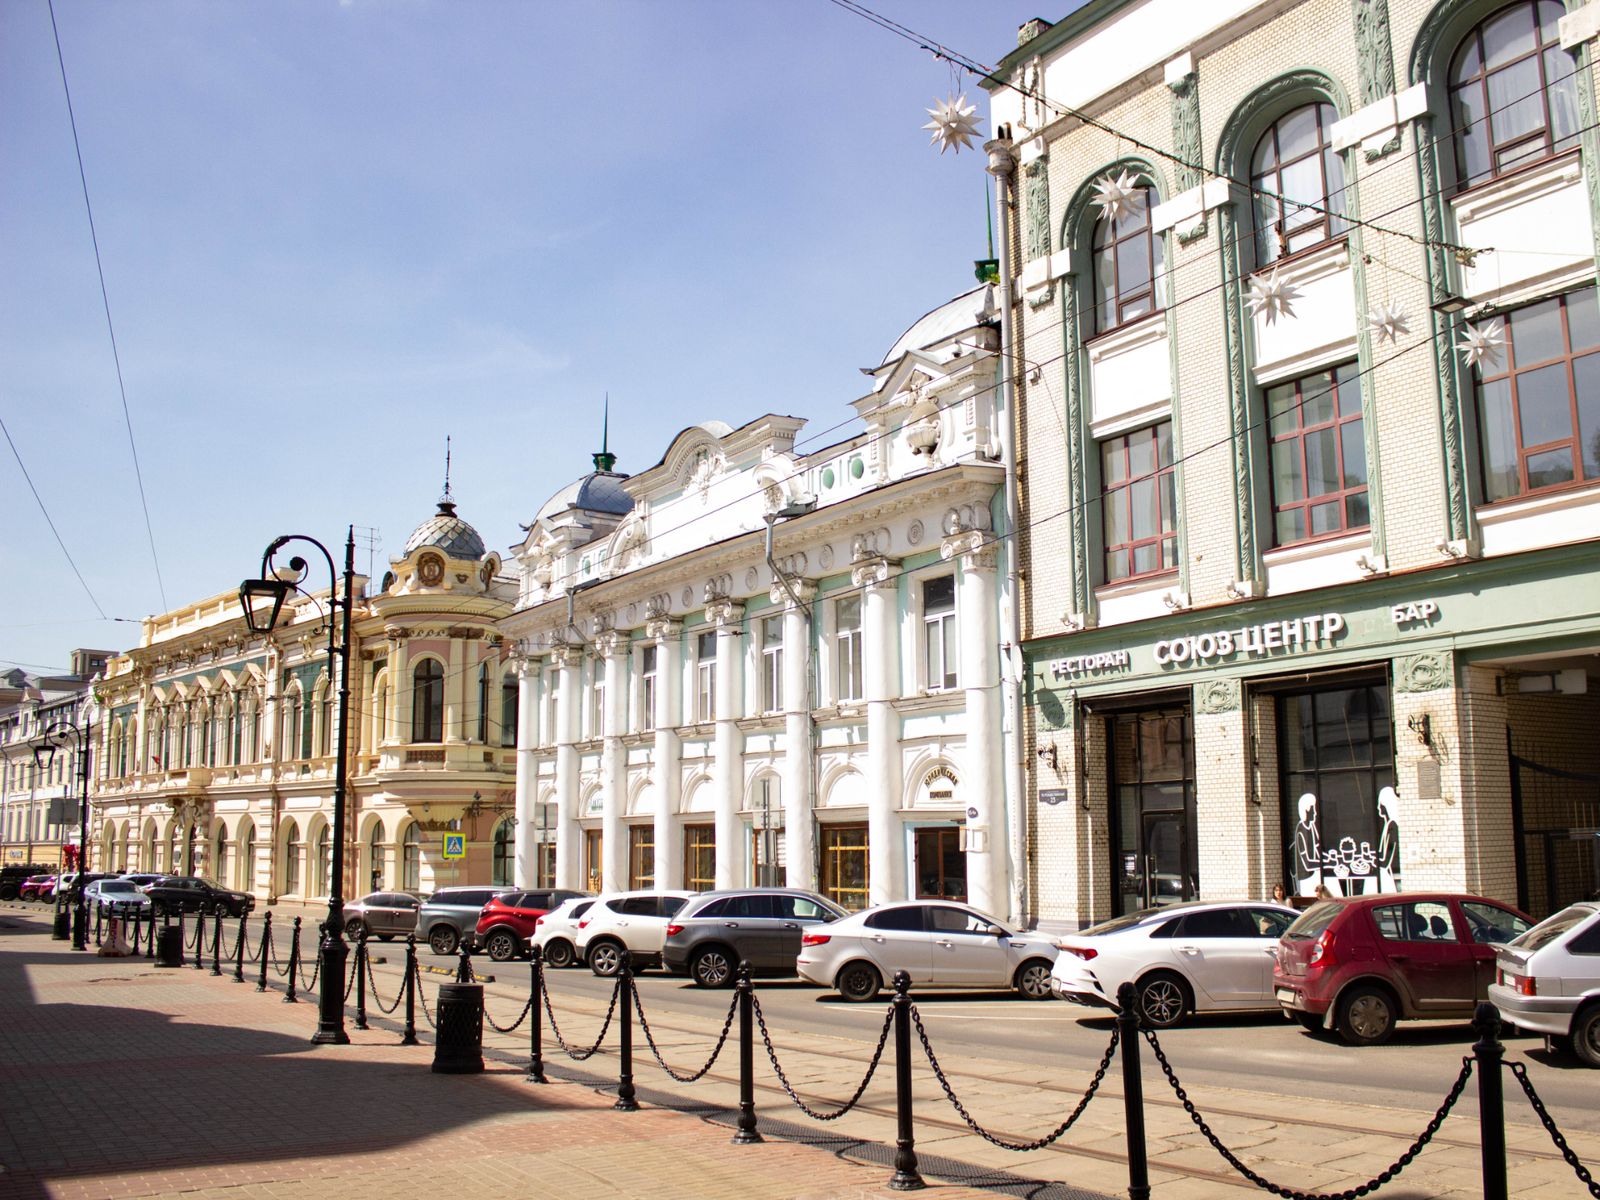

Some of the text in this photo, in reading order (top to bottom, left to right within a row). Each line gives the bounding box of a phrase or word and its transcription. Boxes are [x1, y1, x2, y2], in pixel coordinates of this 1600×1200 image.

[1391, 599, 1438, 623] БАР
[1153, 612, 1345, 665] СОЮЗ ЦЕНТР
[1049, 650, 1129, 675] РЕСТОРАН
